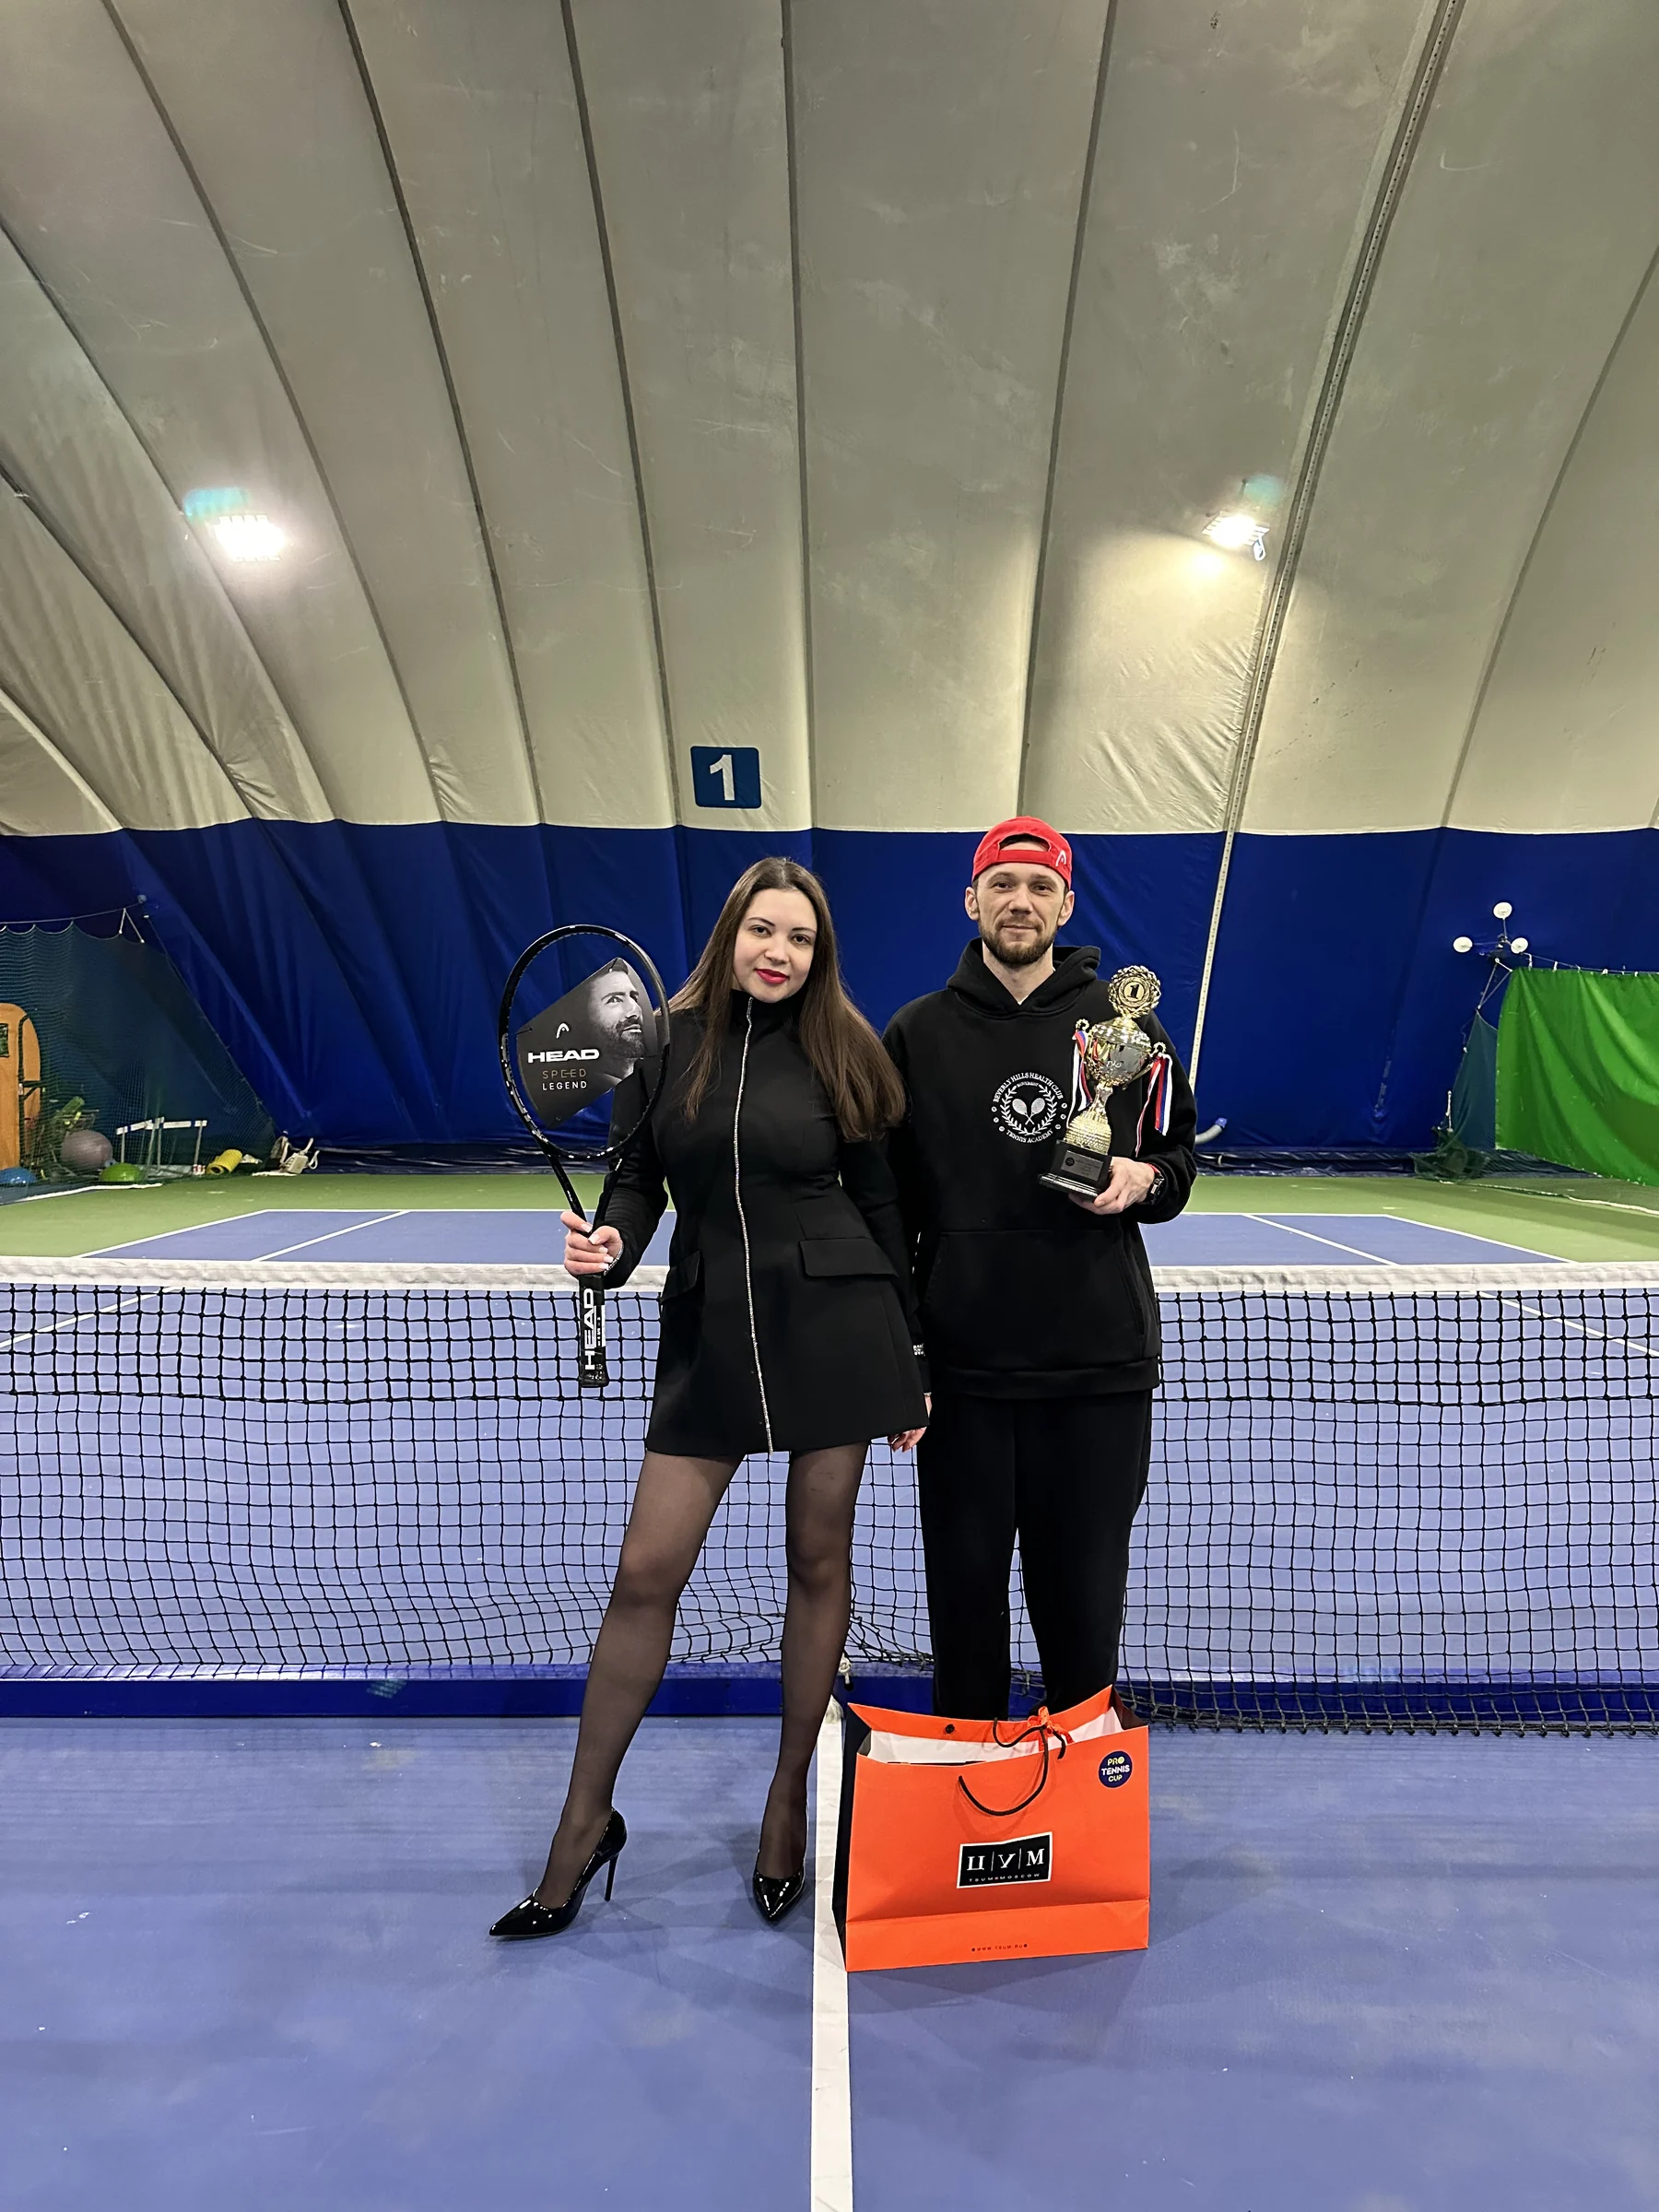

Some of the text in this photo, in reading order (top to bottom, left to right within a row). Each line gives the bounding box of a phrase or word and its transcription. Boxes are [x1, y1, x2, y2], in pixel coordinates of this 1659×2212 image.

[710, 754, 735, 801] 1
[1127, 984, 1140, 999] 1
[527, 1049, 600, 1064] HEAD
[542, 1068, 587, 1079] SPEED
[542, 1080, 587, 1091] LEGEND
[993, 1078, 1011, 1102] BEVERLY
[1010, 1072, 1030, 1083] HILLS
[1030, 1072, 1054, 1087] HEALTH
[1051, 1084, 1064, 1100] CLUB
[1006, 1129, 1053, 1144] TENNIS ACADEMY
[583, 1288, 595, 1371] HEAD
[1107, 1756, 1124, 1766] PRO
[1101, 1764, 1130, 1775] TENNIS
[1108, 1774, 1124, 1783] CUP
